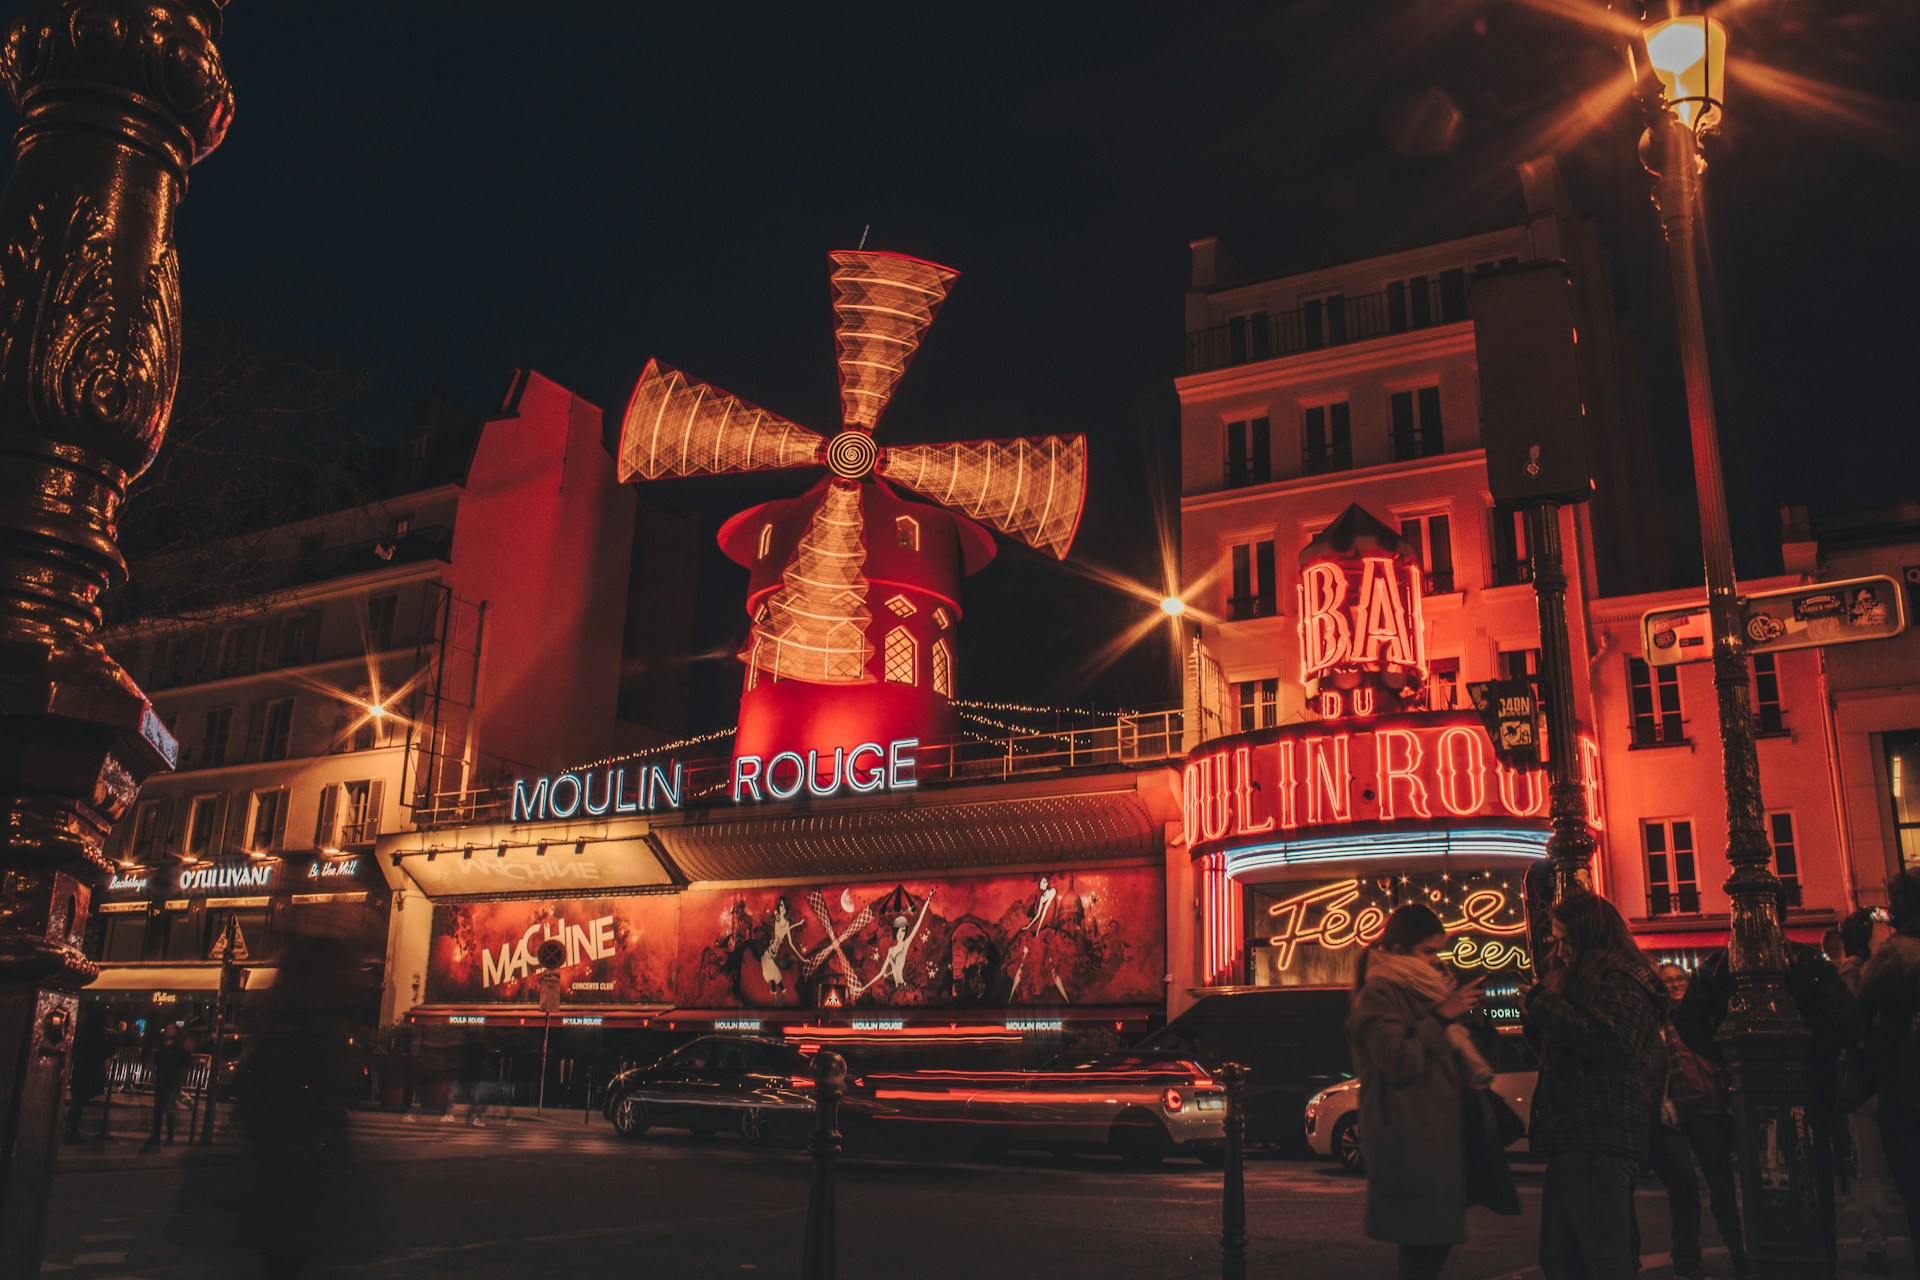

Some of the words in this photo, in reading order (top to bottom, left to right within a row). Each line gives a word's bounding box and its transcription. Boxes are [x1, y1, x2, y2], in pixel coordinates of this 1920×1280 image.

[1322, 689, 1373, 719] DU
[511, 763, 683, 821] MOULIN
[734, 738, 921, 801] ROUGE
[1183, 735, 1352, 851] OULIN
[1375, 727, 1602, 830] ROUE
[572, 982, 599, 991] CONCERTS
[600, 982, 614, 991] CLUB
[1490, 1008, 1520, 1018] DORIS
[715, 1020, 738, 1030] MOULIN
[739, 1020, 761, 1030] ROUGE
[852, 1021, 878, 1030] MOULIN
[879, 1021, 903, 1030] ROUGE
[1006, 1022, 1034, 1030] MOULIN
[1035, 1021, 1062, 1030] ROUGE
